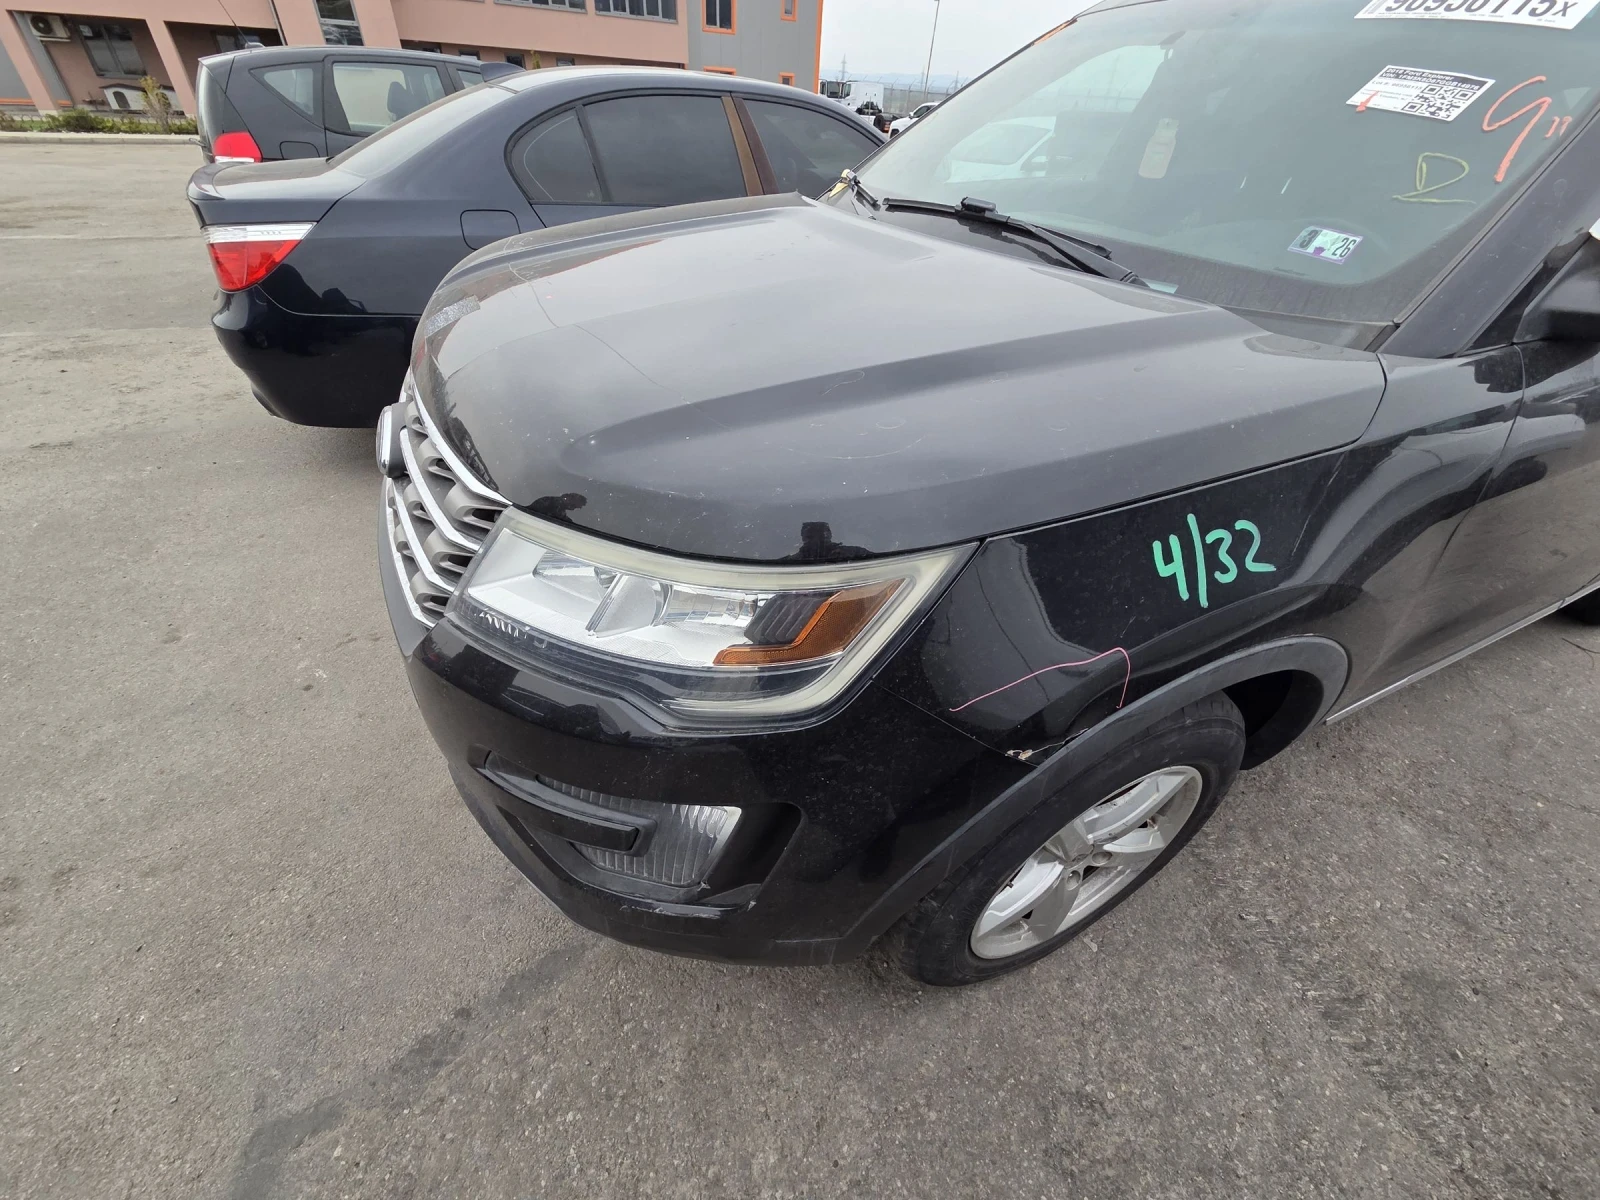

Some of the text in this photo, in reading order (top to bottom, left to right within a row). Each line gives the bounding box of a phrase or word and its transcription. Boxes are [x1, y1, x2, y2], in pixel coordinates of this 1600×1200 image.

[1421, 72, 1455, 80] Explorer
[1299, 229, 1357, 258] 3 26
[1152, 513, 1277, 608] 4/32
